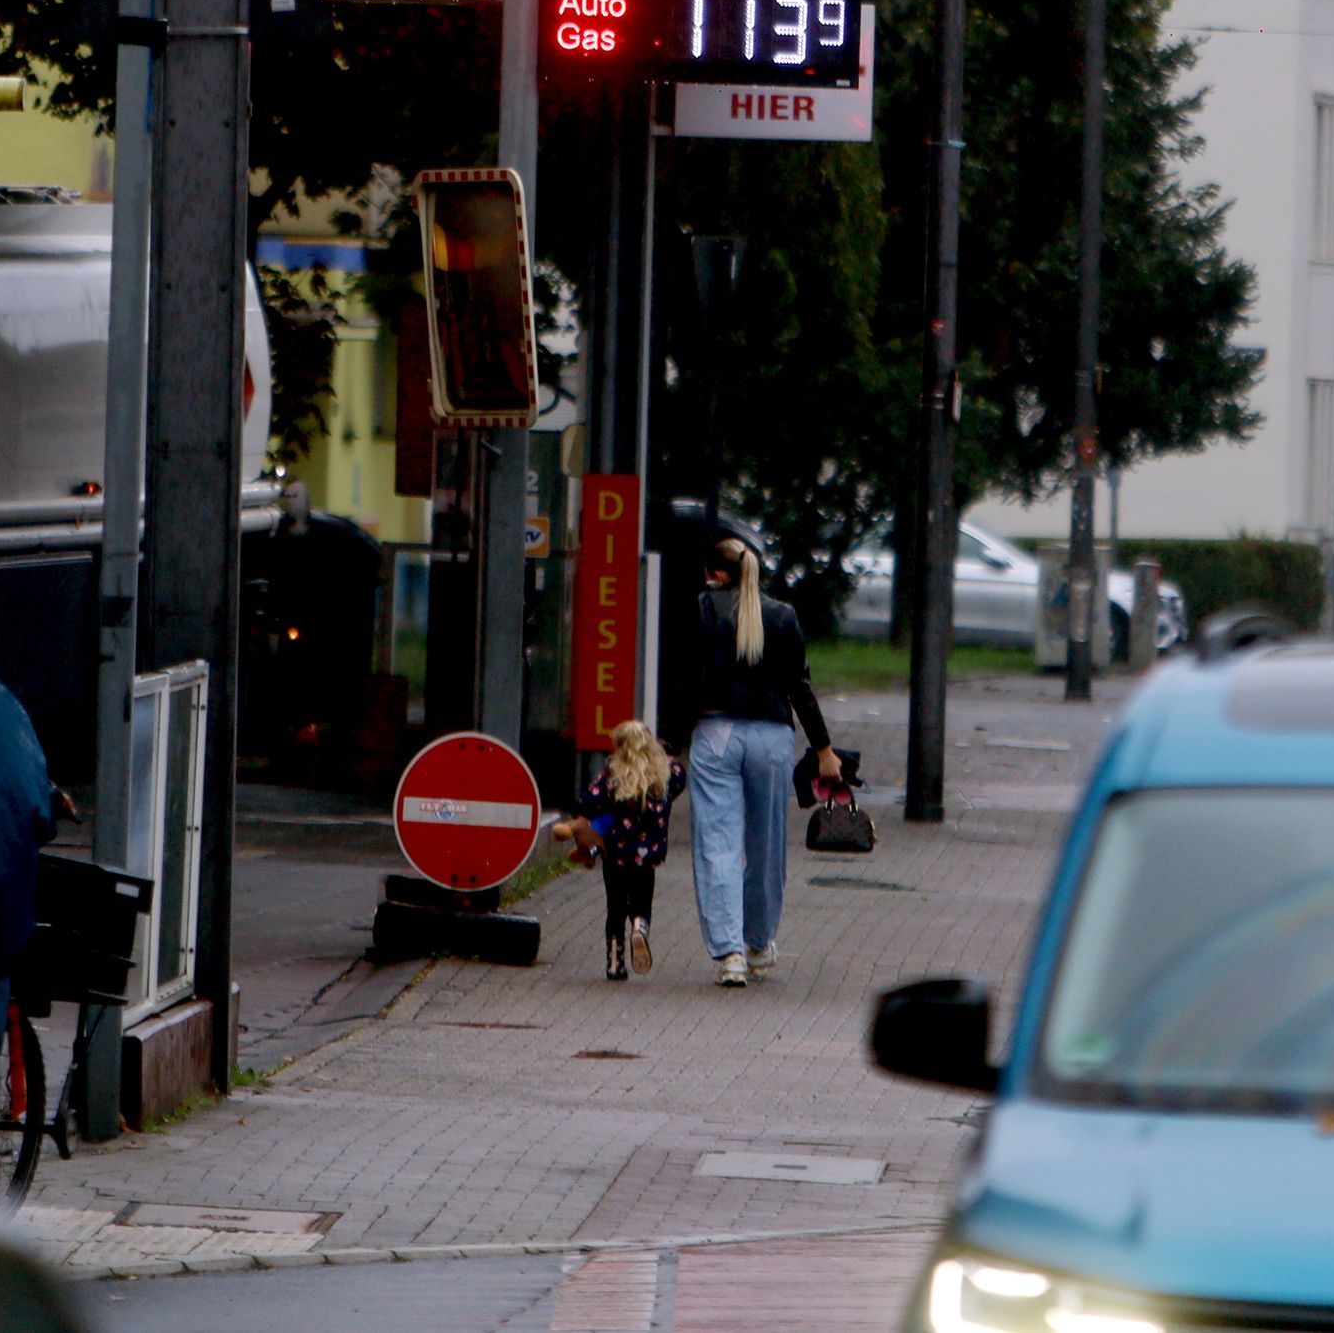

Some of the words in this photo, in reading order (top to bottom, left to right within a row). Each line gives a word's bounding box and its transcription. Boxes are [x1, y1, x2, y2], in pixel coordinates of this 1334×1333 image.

[556, 24, 616, 52] Gas
[729, 94, 815, 122] HIER
[594, 490, 625, 737] DIESEL
